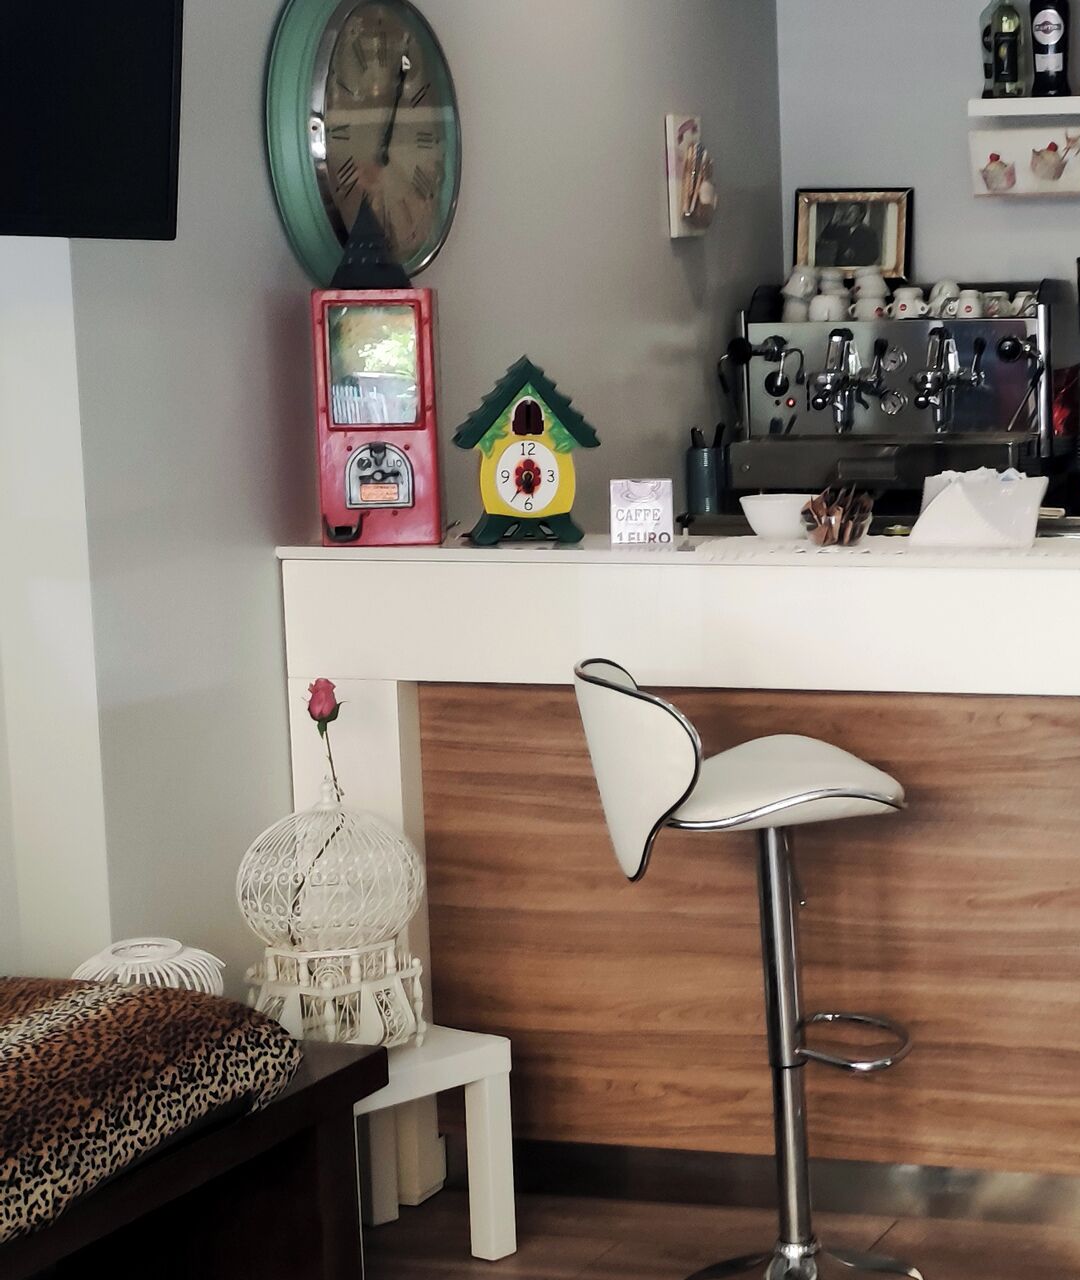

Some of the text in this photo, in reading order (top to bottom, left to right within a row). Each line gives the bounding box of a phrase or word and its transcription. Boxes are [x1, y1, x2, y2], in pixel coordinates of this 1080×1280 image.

[520, 442, 536, 456] 12
[501, 469, 510, 484] 9
[546, 469, 556, 483] 3
[524, 497, 533, 511] 6
